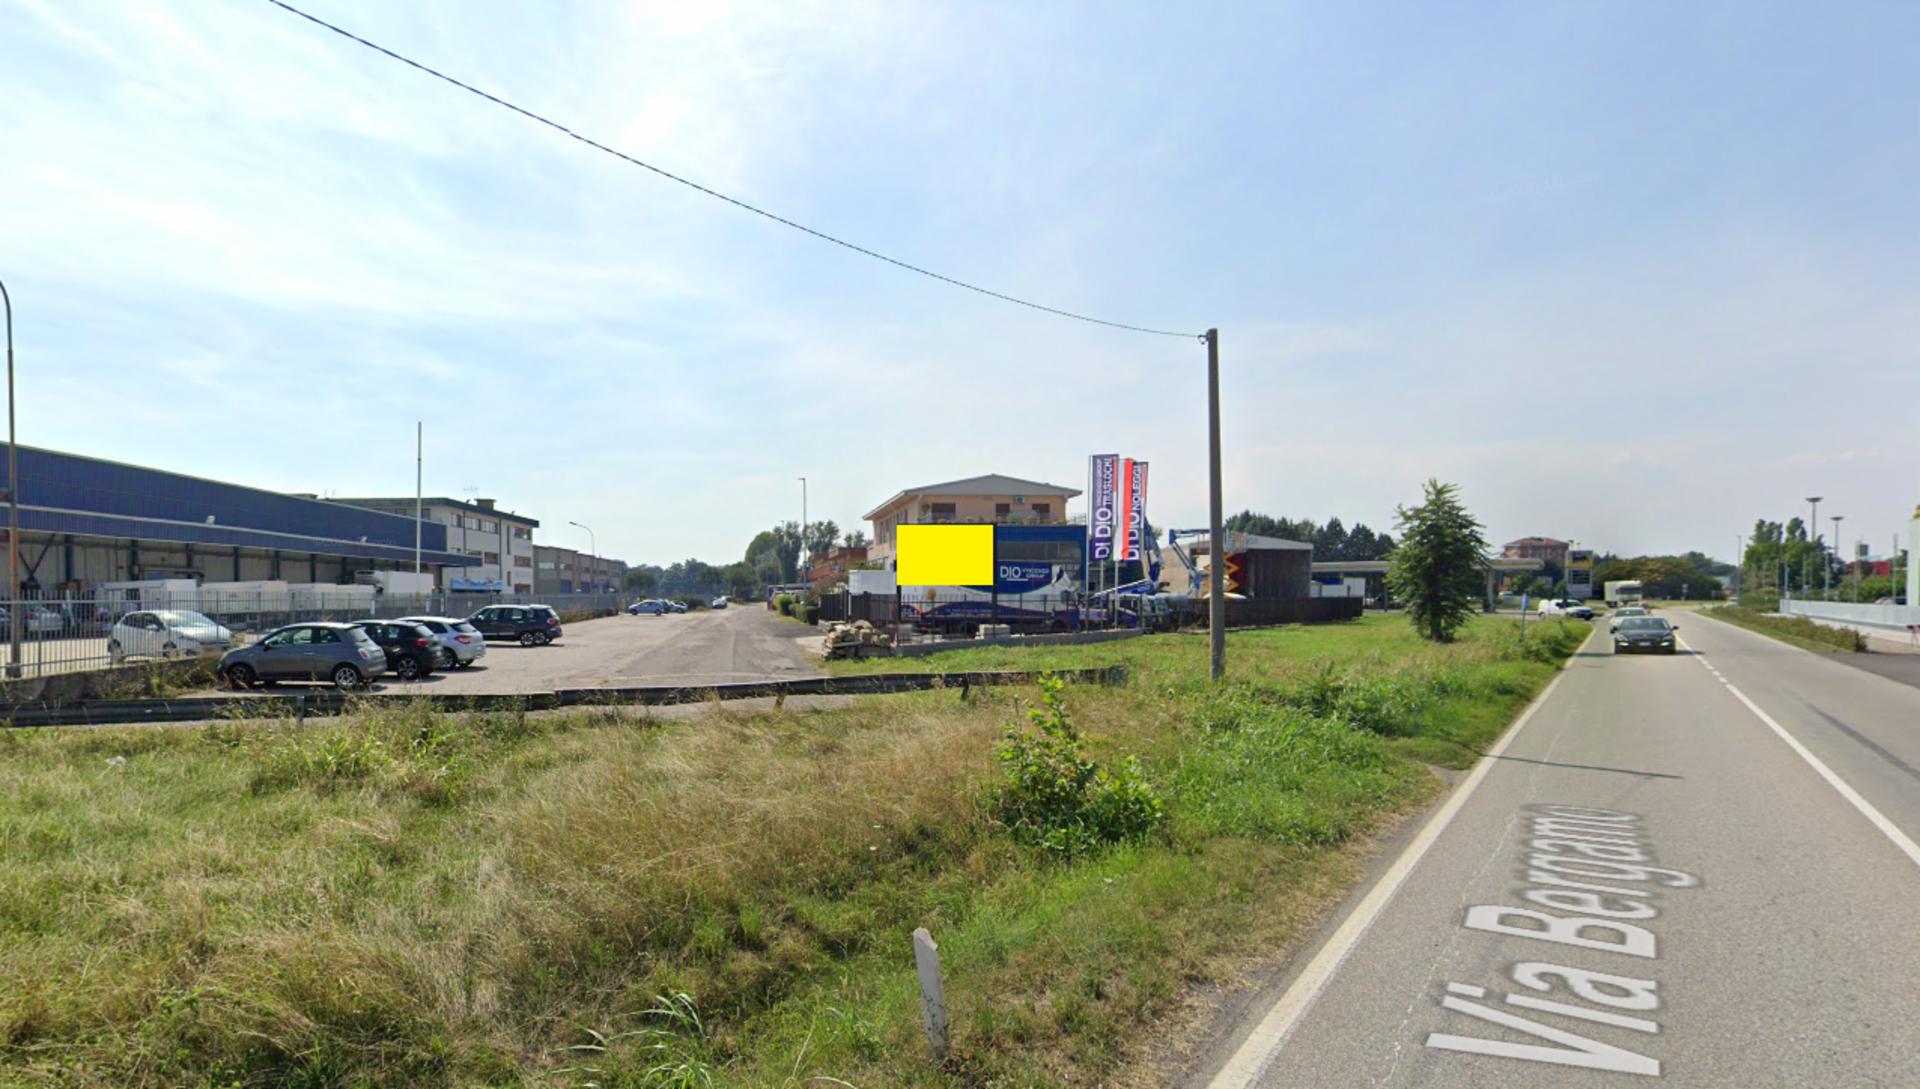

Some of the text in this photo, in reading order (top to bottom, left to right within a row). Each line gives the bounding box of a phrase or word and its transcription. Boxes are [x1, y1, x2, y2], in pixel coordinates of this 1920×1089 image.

[1095, 508, 1112, 559] DI DIO
[1129, 513, 1140, 540] DIO
[1128, 543, 1139, 560] DI
